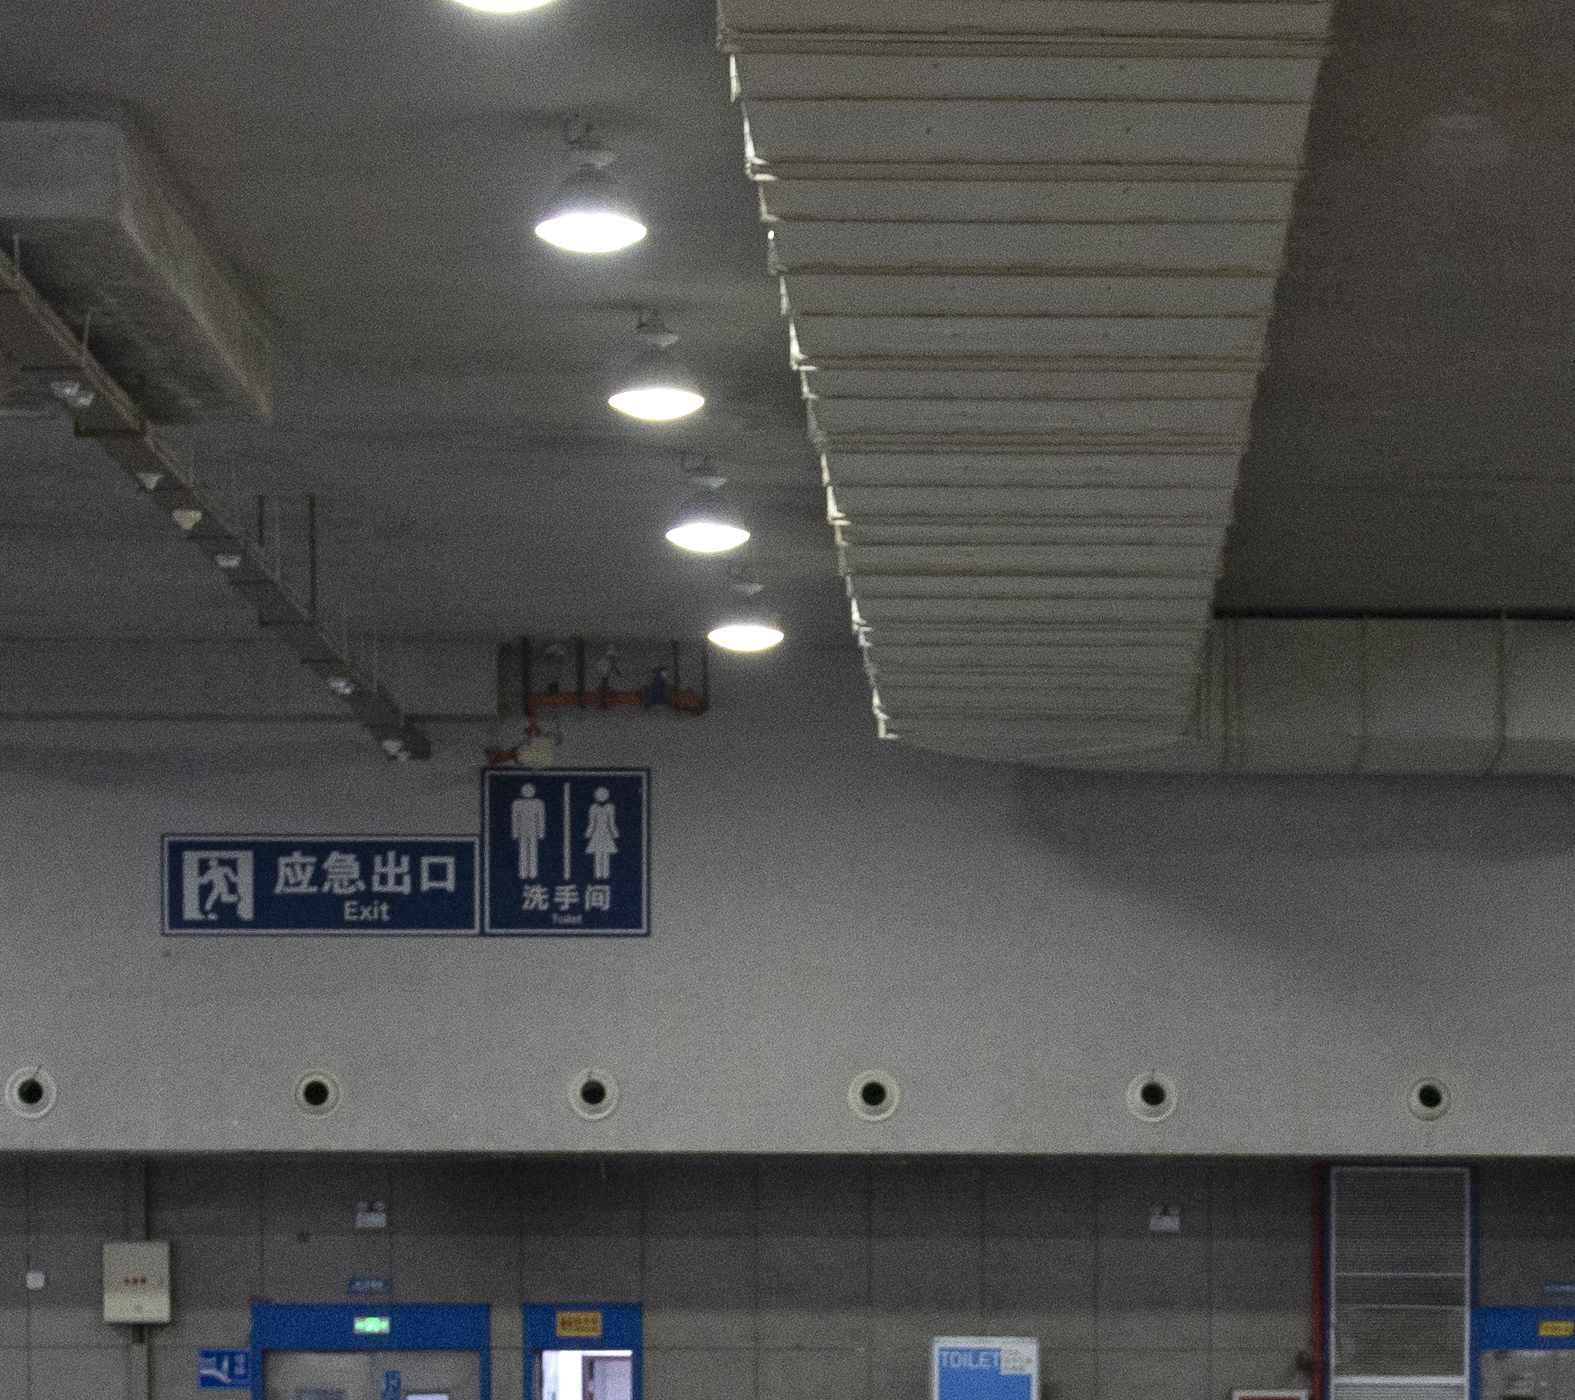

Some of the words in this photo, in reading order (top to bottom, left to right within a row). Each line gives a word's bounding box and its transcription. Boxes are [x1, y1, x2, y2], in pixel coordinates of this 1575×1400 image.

[273, 850, 457, 896] 应急出口
[521, 884, 612, 912] 洗手间
[343, 900, 391, 922] Exit
[940, 1350, 1001, 1370] TOILET
